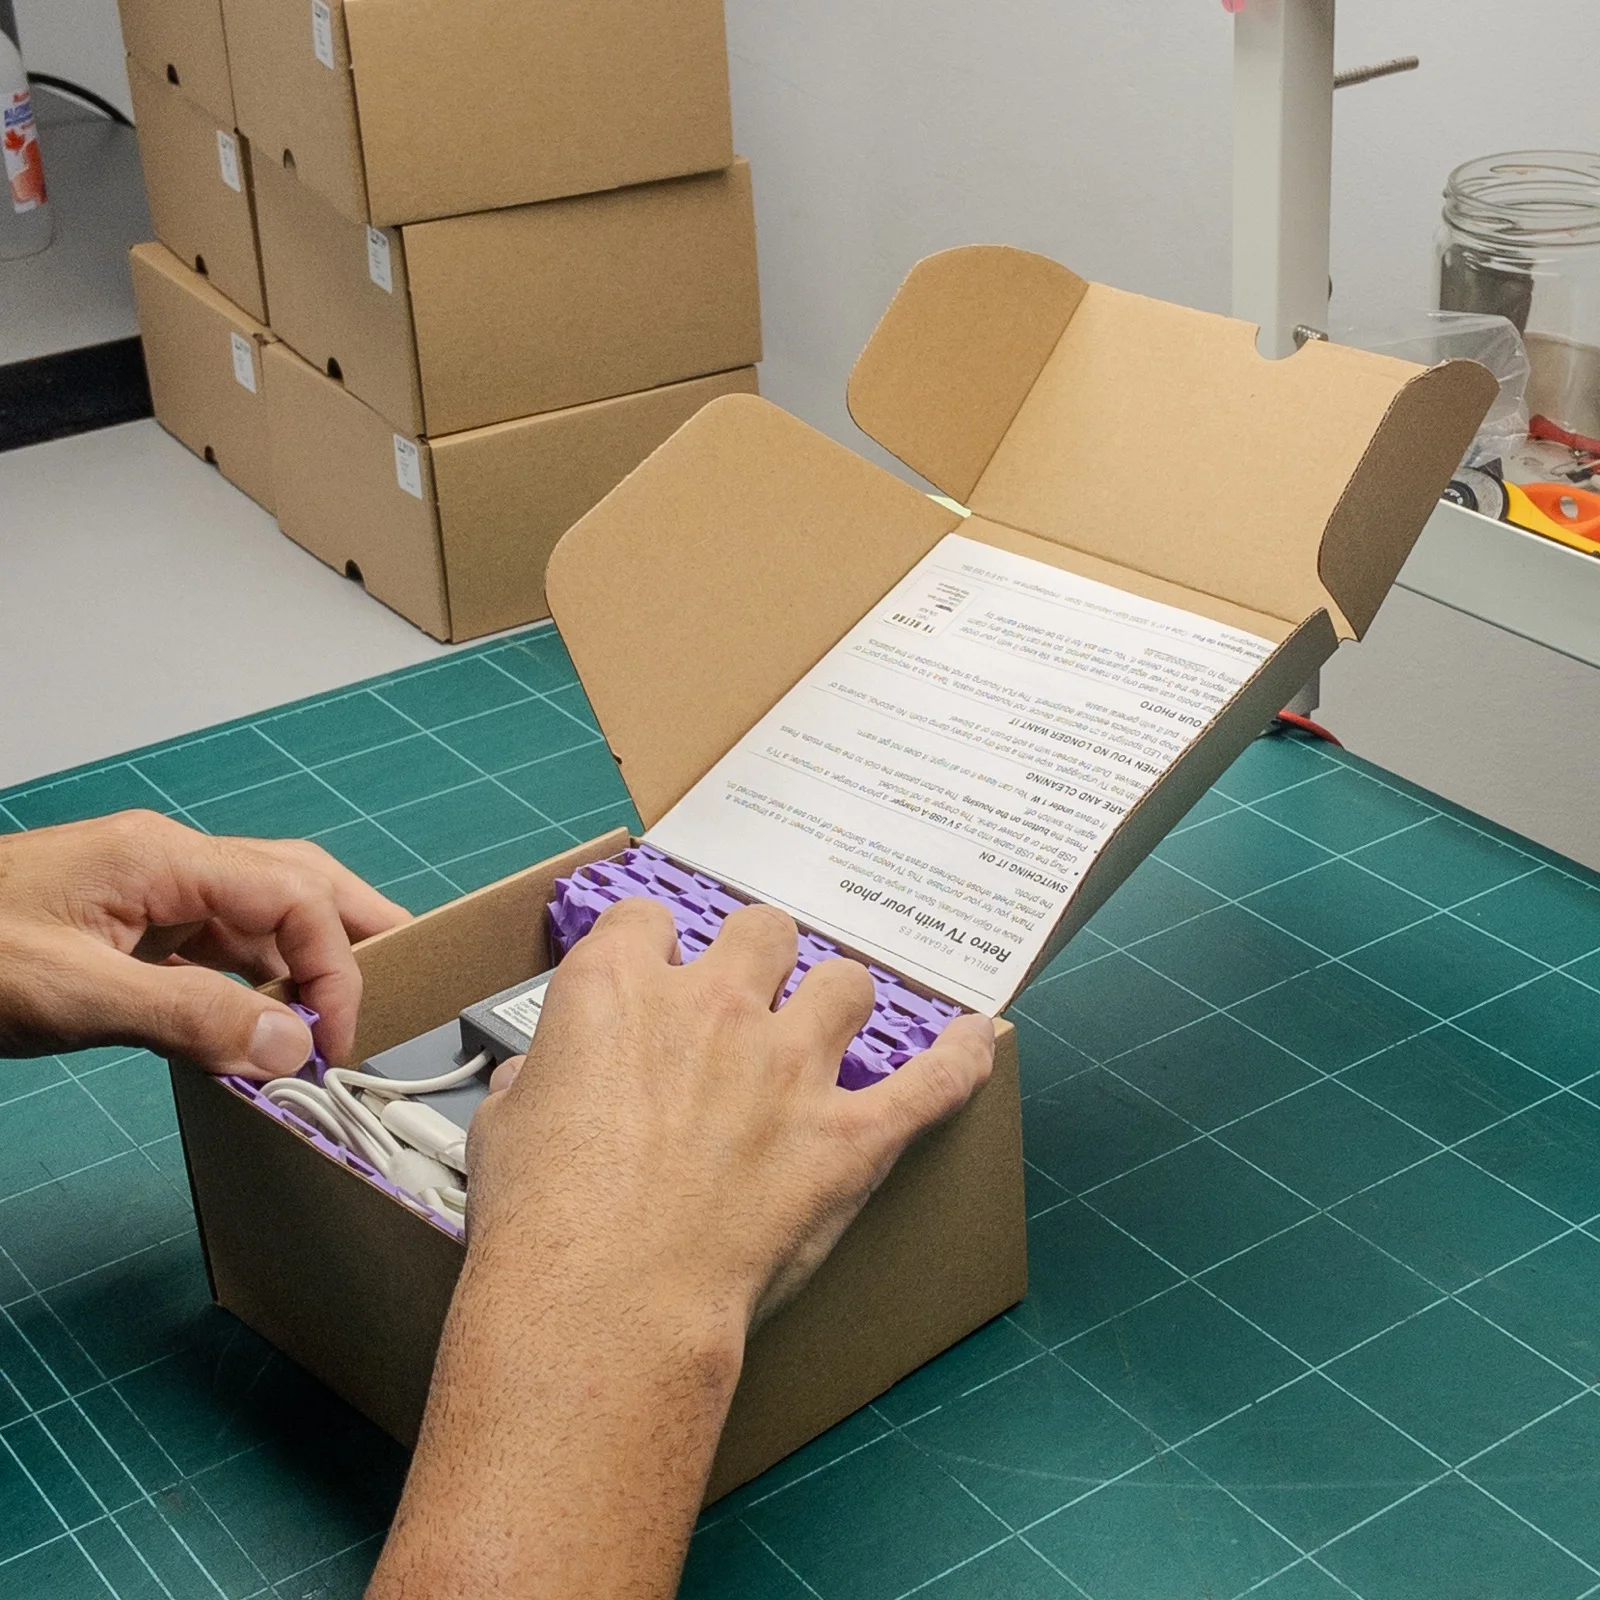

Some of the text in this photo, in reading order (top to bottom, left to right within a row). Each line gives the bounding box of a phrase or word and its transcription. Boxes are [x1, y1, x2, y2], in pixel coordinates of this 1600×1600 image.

[892, 613, 921, 628] RETRO
[921, 624, 935, 634] TV
[979, 633, 997, 641] your
[1019, 645, 1038, 656] keep
[1137, 659, 1197, 682] and then delete
[972, 675, 1002, 691] housing
[1121, 676, 1138, 686] only
[1149, 675, 1174, 687] 3-year
[1001, 687, 1018, 696] PLA
[1138, 683, 1159, 693] used
[1174, 683, 1188, 692] the
[1188, 688, 1201, 697] for
[1018, 692, 1032, 701] The
[1159, 690, 1176, 699] was
[1176, 696, 1202, 707] photo
[1073, 710, 1110, 725] electrical
[1107, 710, 1140, 723] general
[1138, 701, 1207, 728] OUR PHOTO
[928, 718, 950, 731] damp
[1007, 717, 1021, 726] IT
[1138, 720, 1156, 730] with
[780, 726, 800, 737] Press
[1019, 721, 1048, 736] WANT
[1111, 723, 1141, 737] collects
[1050, 731, 1092, 750] LONGER
[1107, 734, 1143, 750] spotlight
[1141, 733, 1159, 744] that
[1160, 739, 1181, 750] shop
[903, 747, 922, 758] does
[989, 730, 1111, 777] Dust the screen with soft brush
[994, 744, 1011, 752] soft
[1092, 746, 1110, 757] NO
[1142, 747, 1162, 758] LED
[842, 750, 856, 759] the
[1016, 752, 1033, 761] with
[1109, 752, 1132, 766] YOU
[864, 759, 882, 768] click
[1034, 758, 1053, 768] wipe
[894, 771, 921, 784] passes
[977, 775, 998, 787] leave
[736, 786, 767, 801] switched
[859, 785, 884, 797] phone
[920, 781, 944, 794] button
[1025, 772, 1130, 815] ARE AND CLEANING
[1110, 786, 1126, 796] the
[945, 790, 958, 800] The
[1013, 789, 1028, 799] You
[930, 801, 959, 815] charger
[963, 796, 994, 814] housing.
[1048, 802, 1074, 815] under
[919, 810, 947, 824] USB-A
[959, 812, 972, 822] The
[994, 810, 1009, 819] the
[1023, 807, 1037, 816] off.
[807, 815, 822, 824] you
[976, 818, 997, 831] bank.
[1036, 813, 1064, 826] switch
[1074, 812, 1100, 826] draws
[961, 825, 977, 835] any
[997, 827, 1023, 840] power
[1021, 820, 1049, 836] button
[1074, 827, 1098, 839] again
[832, 826, 866, 844] Switched
[976, 832, 993, 843] into
[1050, 832, 1065, 841] the
[833, 840, 856, 852] photo
[992, 838, 1015, 850] cable
[1039, 844, 1058, 854] port
[1064, 837, 1089, 851] Press
[855, 849, 874, 859] your
[892, 851, 905, 860] the
[1015, 848, 1035, 860] USB
[1035, 855, 1049, 865] the
[1057, 851, 1078, 863] USB
[872, 856, 895, 870] keeps
[905, 856, 928, 870] draws
[1049, 859, 1069, 873] Plug
[847, 864, 885, 883] 3D-printed
[893, 866, 905, 875] TV
[907, 871, 922, 882] This
[929, 866, 966, 886] thickness
[978, 851, 1068, 893] SWITCHING IT ON
[885, 879, 906, 891] single
[966, 882, 991, 896] whose
[914, 890, 937, 906] Spain,
[963, 895, 983, 906] your
[992, 893, 1015, 906] sheet
[1015, 888, 1054, 909] the photo.
[981, 903, 994, 912] for
[994, 908, 1011, 918] you
[1015, 903, 1046, 918] printed
[839, 879, 1010, 962] Retro TV with your photo
[1010, 915, 1035, 931] Thank
[1003, 930, 1024, 944] Made
[963, 955, 998, 974] BRILLA
